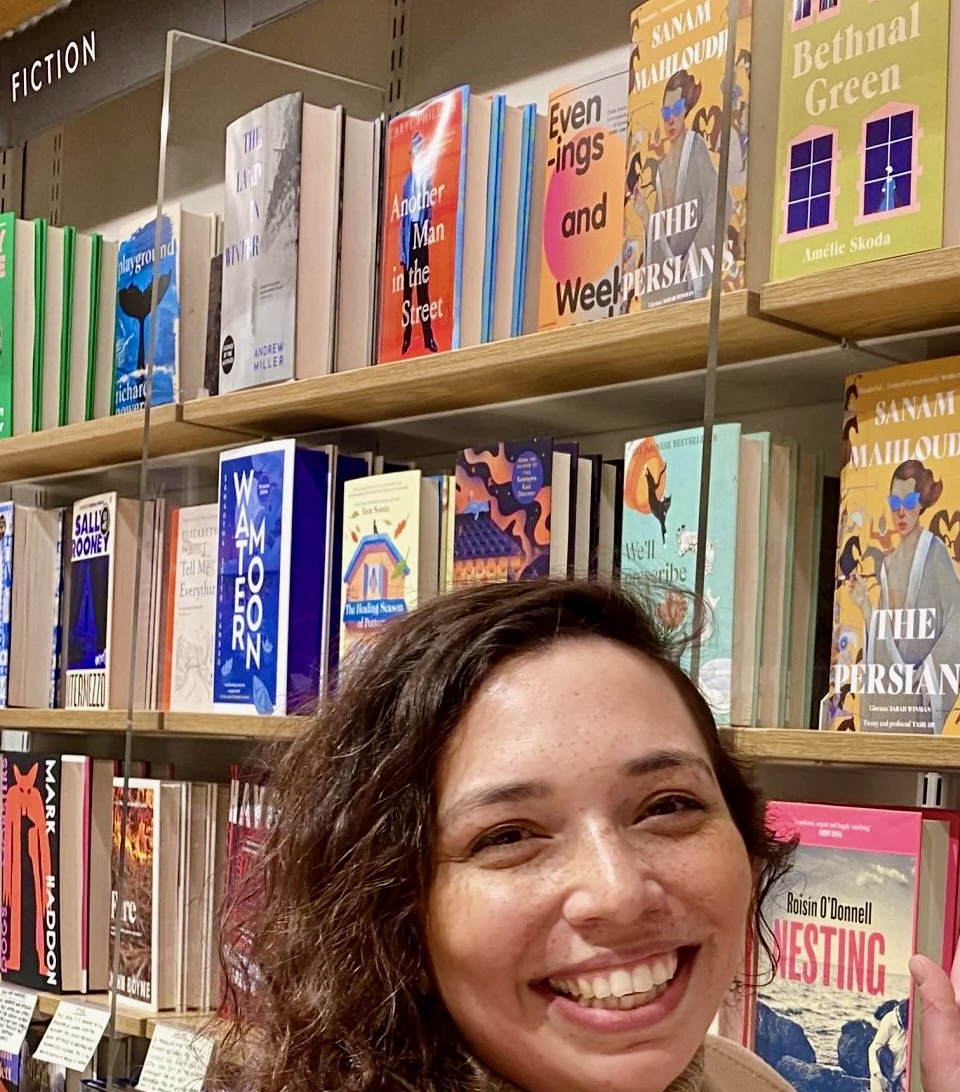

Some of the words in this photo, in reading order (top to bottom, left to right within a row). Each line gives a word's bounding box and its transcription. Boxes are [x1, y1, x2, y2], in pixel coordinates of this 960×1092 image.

[651, 0, 711, 49] SANAM
[791, 2, 921, 79] Bethnal
[12, 30, 96, 103] FICTION
[634, 28, 728, 93] MAHLOUDJI
[805, 63, 902, 116] Green
[549, 94, 601, 140] Even
[547, 132, 604, 176] -ings
[390, 182, 445, 221] Another
[561, 191, 607, 239] and
[648, 199, 698, 242] THE
[413, 221, 445, 250] Man
[802, 236, 845, 263] Amélie
[850, 231, 891, 255] Skoda
[392, 267, 405, 293] in
[409, 257, 430, 287] the
[621, 239, 735, 301] PERSIANS
[402, 297, 443, 328] Street
[254, 341, 284, 359] ANDREW
[254, 355, 284, 372] MILLER
[873, 390, 955, 427] SANAM
[75, 508, 103, 538] SALL
[233, 469, 255, 651] WATER
[246, 516, 267, 670] MOON
[873, 607, 936, 642] THE
[45, 759, 57, 834] MARK
[786, 891, 818, 919] Roisín
[46, 875, 58, 986] HADDON
[773, 918, 886, 996] NESTING
[127, 976, 152, 999] BOYNE
